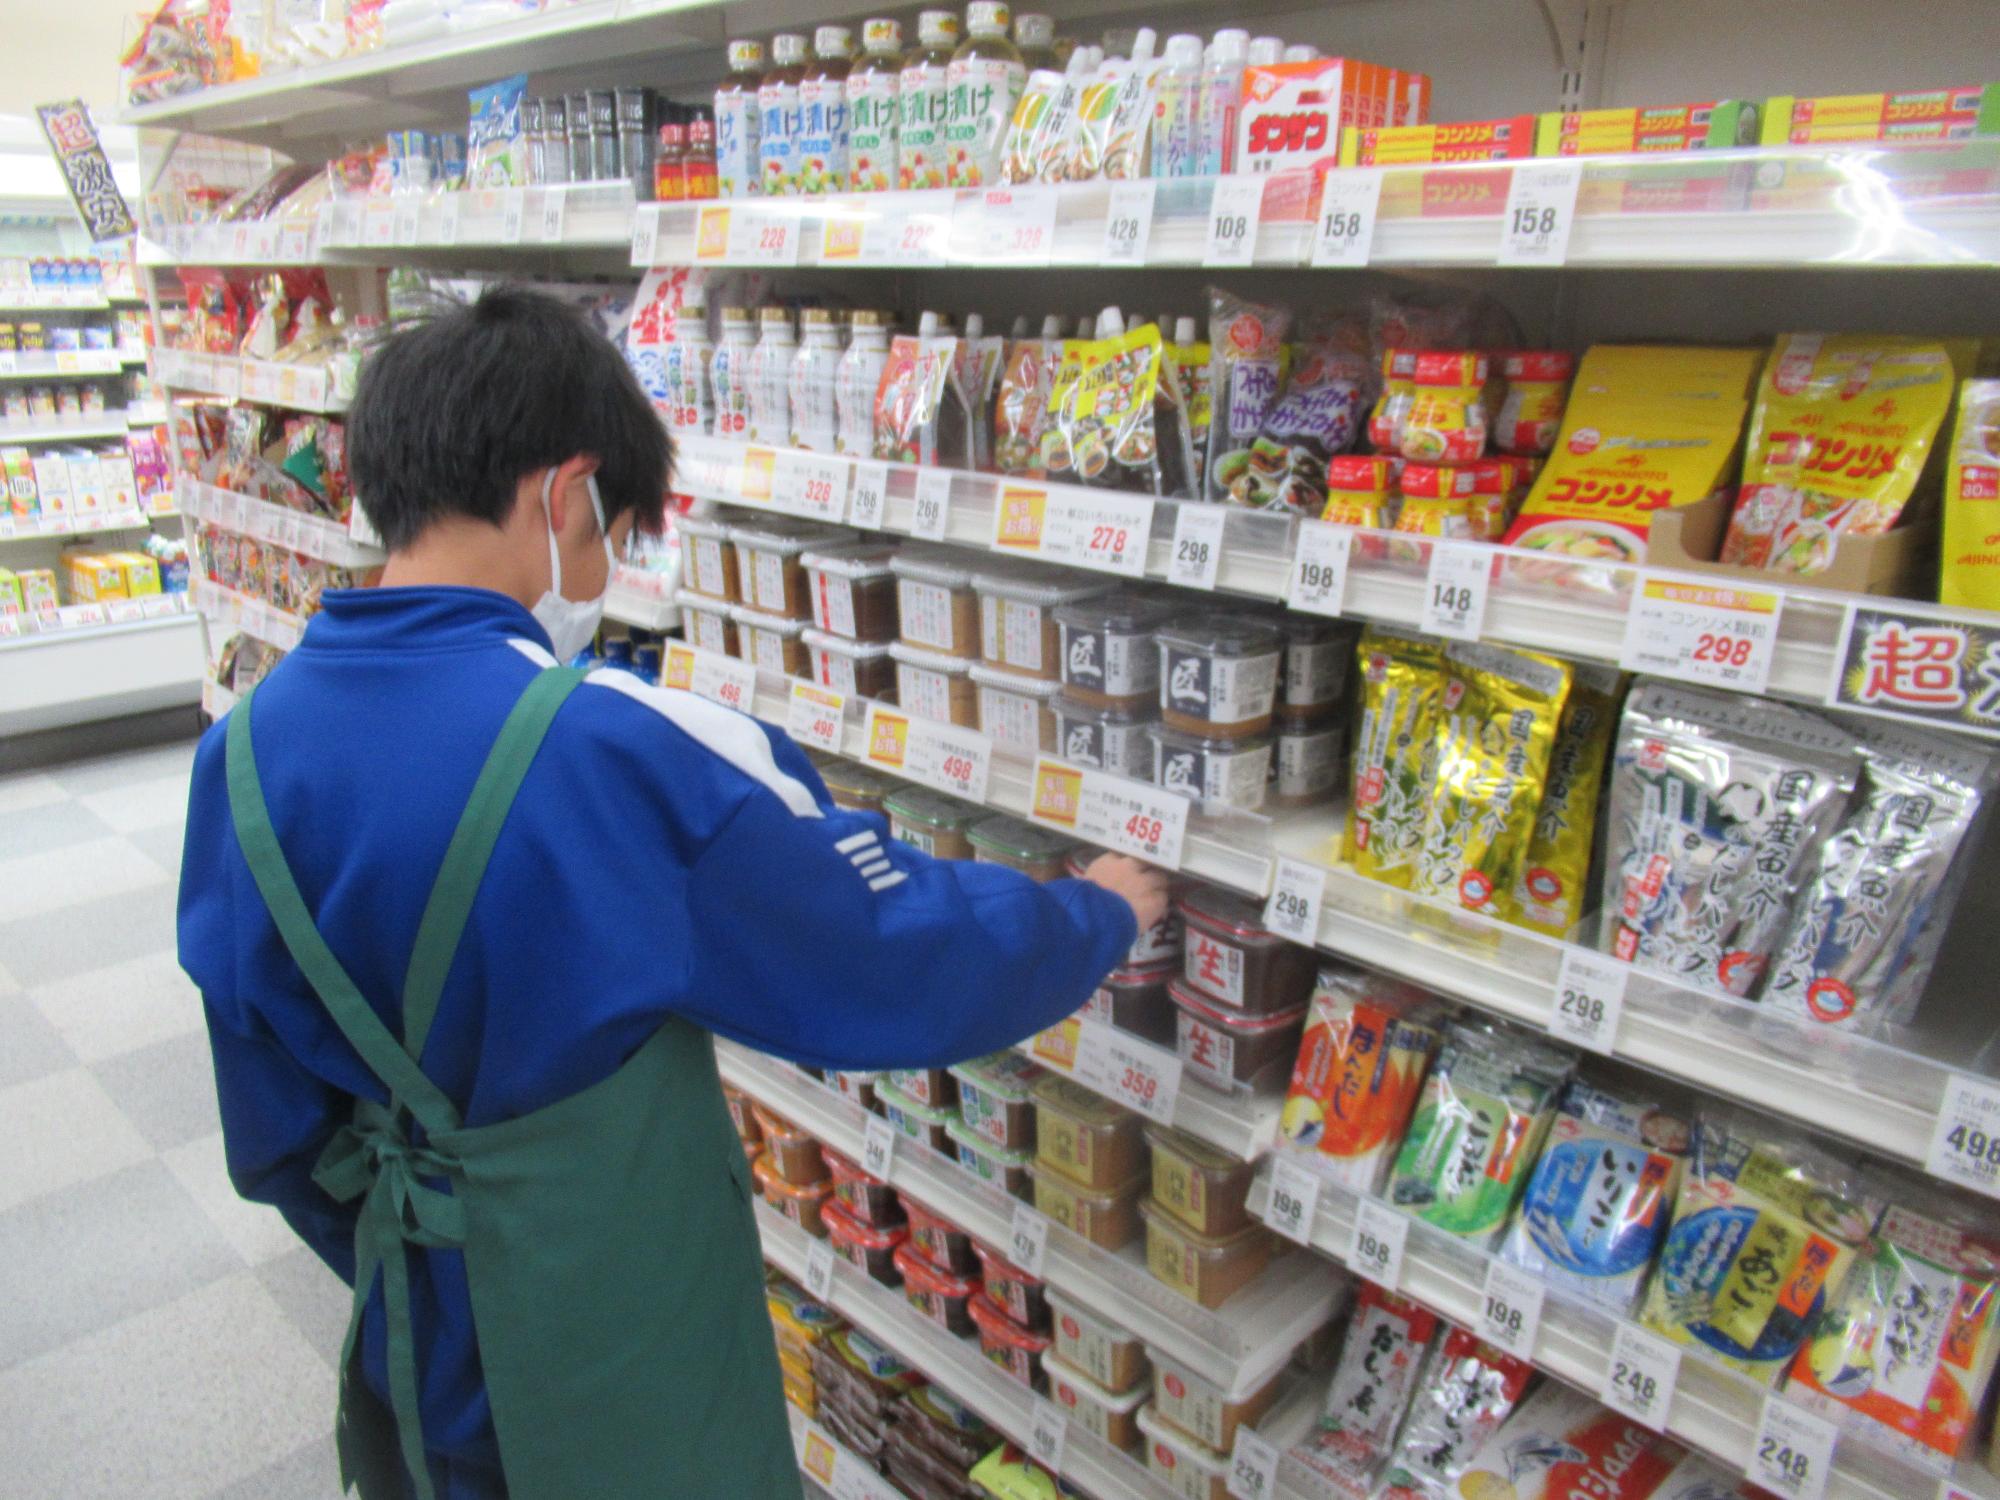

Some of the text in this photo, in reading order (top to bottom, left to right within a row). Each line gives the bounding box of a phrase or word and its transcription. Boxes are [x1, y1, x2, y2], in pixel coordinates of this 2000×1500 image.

[1247, 112, 1329, 154] タンサン
[1435, 126, 1493, 145] コンソメ
[1109, 218, 1139, 241] 428
[1215, 214, 1246, 239] 108
[1324, 212, 1361, 238] 158
[1512, 207, 1557, 235] 158
[759, 226, 787, 249] 228
[1764, 431, 1901, 480] コンソメ
[805, 480, 832, 502] 328
[857, 489, 878, 510] 268
[1546, 478, 1673, 511] コンソメ
[917, 499, 940, 520] 268
[1090, 526, 1127, 553] 278
[1178, 539, 1210, 564] 298
[1300, 562, 1334, 589] 198
[1434, 583, 1472, 612] 148
[1693, 632, 1753, 666] 298
[720, 683, 741, 704] 498
[813, 718, 834, 739] 498
[943, 755, 973, 782] 498
[1126, 814, 1163, 844] 458
[1275, 891, 1309, 920] 298
[1195, 941, 1226, 988] 生
[1560, 989, 1605, 1022] 298
[1189, 1022, 1217, 1070] 生
[1121, 1067, 1157, 1099] 358
[1946, 1124, 2000, 1165] 498
[1273, 1188, 1302, 1219] 198
[1357, 1232, 1390, 1260] 198
[1485, 1296, 1523, 1332] 198
[1611, 1361, 1657, 1400] 248
[1758, 1436, 1810, 1479] 248
[1234, 1459, 1264, 1491] 228
